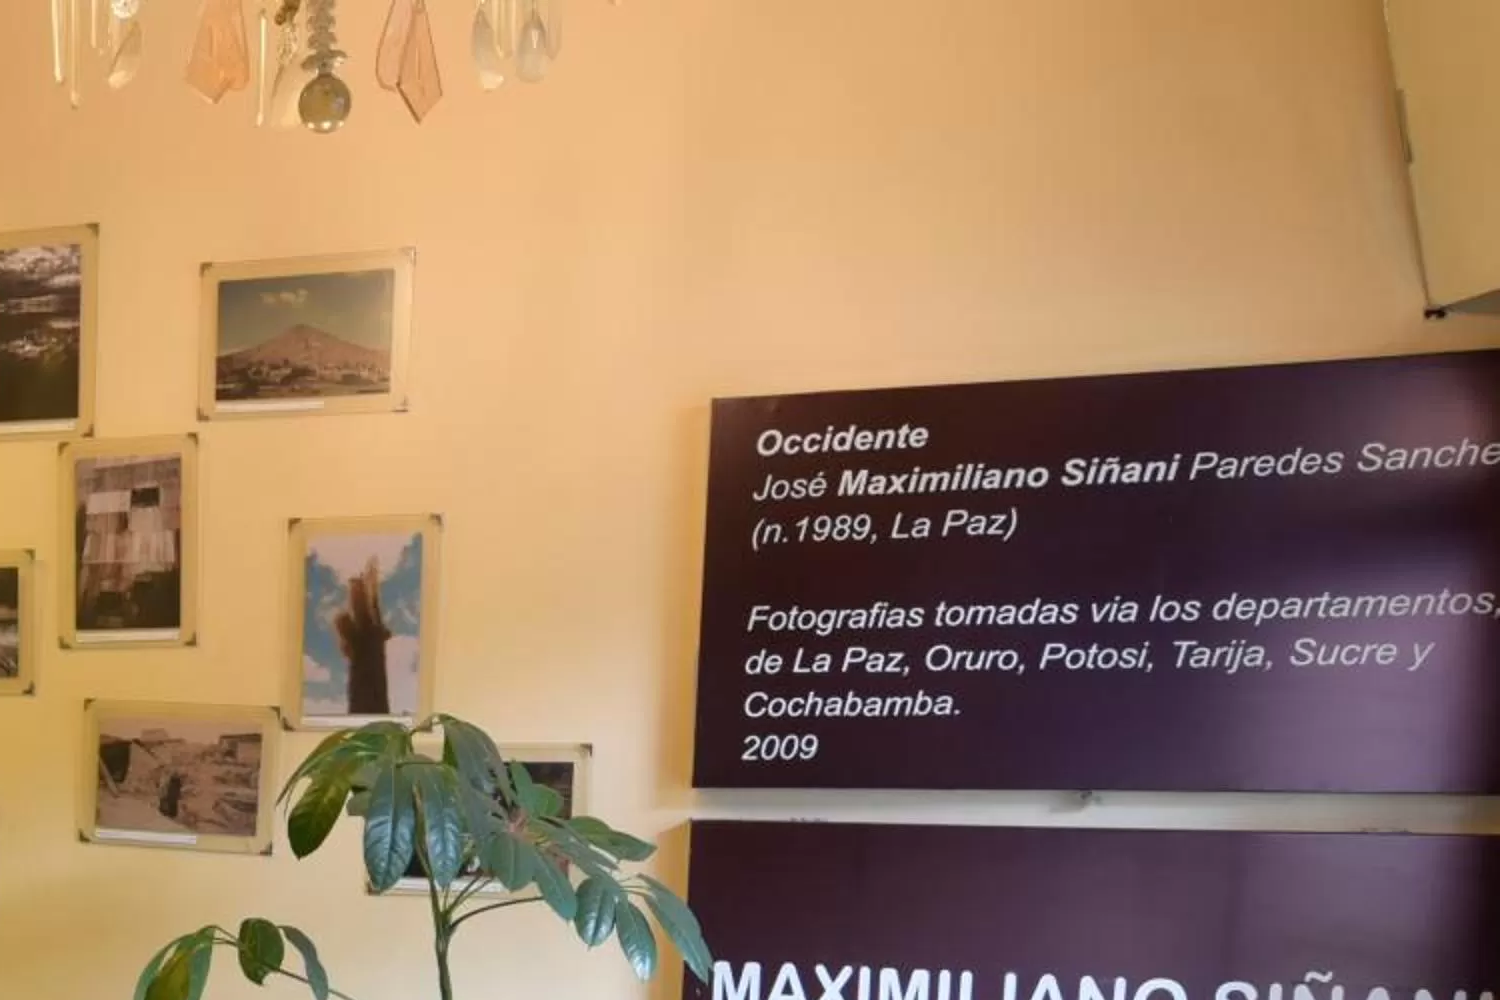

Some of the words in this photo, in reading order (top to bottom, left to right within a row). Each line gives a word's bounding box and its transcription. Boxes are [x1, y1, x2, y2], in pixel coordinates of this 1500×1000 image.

[755, 422, 930, 458] Occidente
[751, 470, 829, 502] José
[837, 462, 1051, 497] Maximiliano
[1059, 451, 1184, 488] Siñani
[1188, 446, 1346, 481] Paredes
[888, 511, 933, 540] La
[940, 506, 1019, 543] Paz)
[746, 600, 926, 638] Fotografias
[933, 596, 1081, 628] tomadas
[1090, 595, 1140, 624] via
[1148, 593, 1203, 623] los
[1211, 587, 1500, 627] departamentos,
[743, 647, 784, 676] de
[791, 646, 833, 674] La
[840, 645, 911, 678] Paz,
[924, 643, 1026, 676] Oruro,
[1038, 639, 1154, 673] Potosi,
[1171, 638, 1274, 675] Tarija,
[1289, 637, 1398, 667] Sucre
[1407, 642, 1436, 672] y
[742, 688, 962, 719] Cochabamba.
[740, 732, 820, 762] 2009
